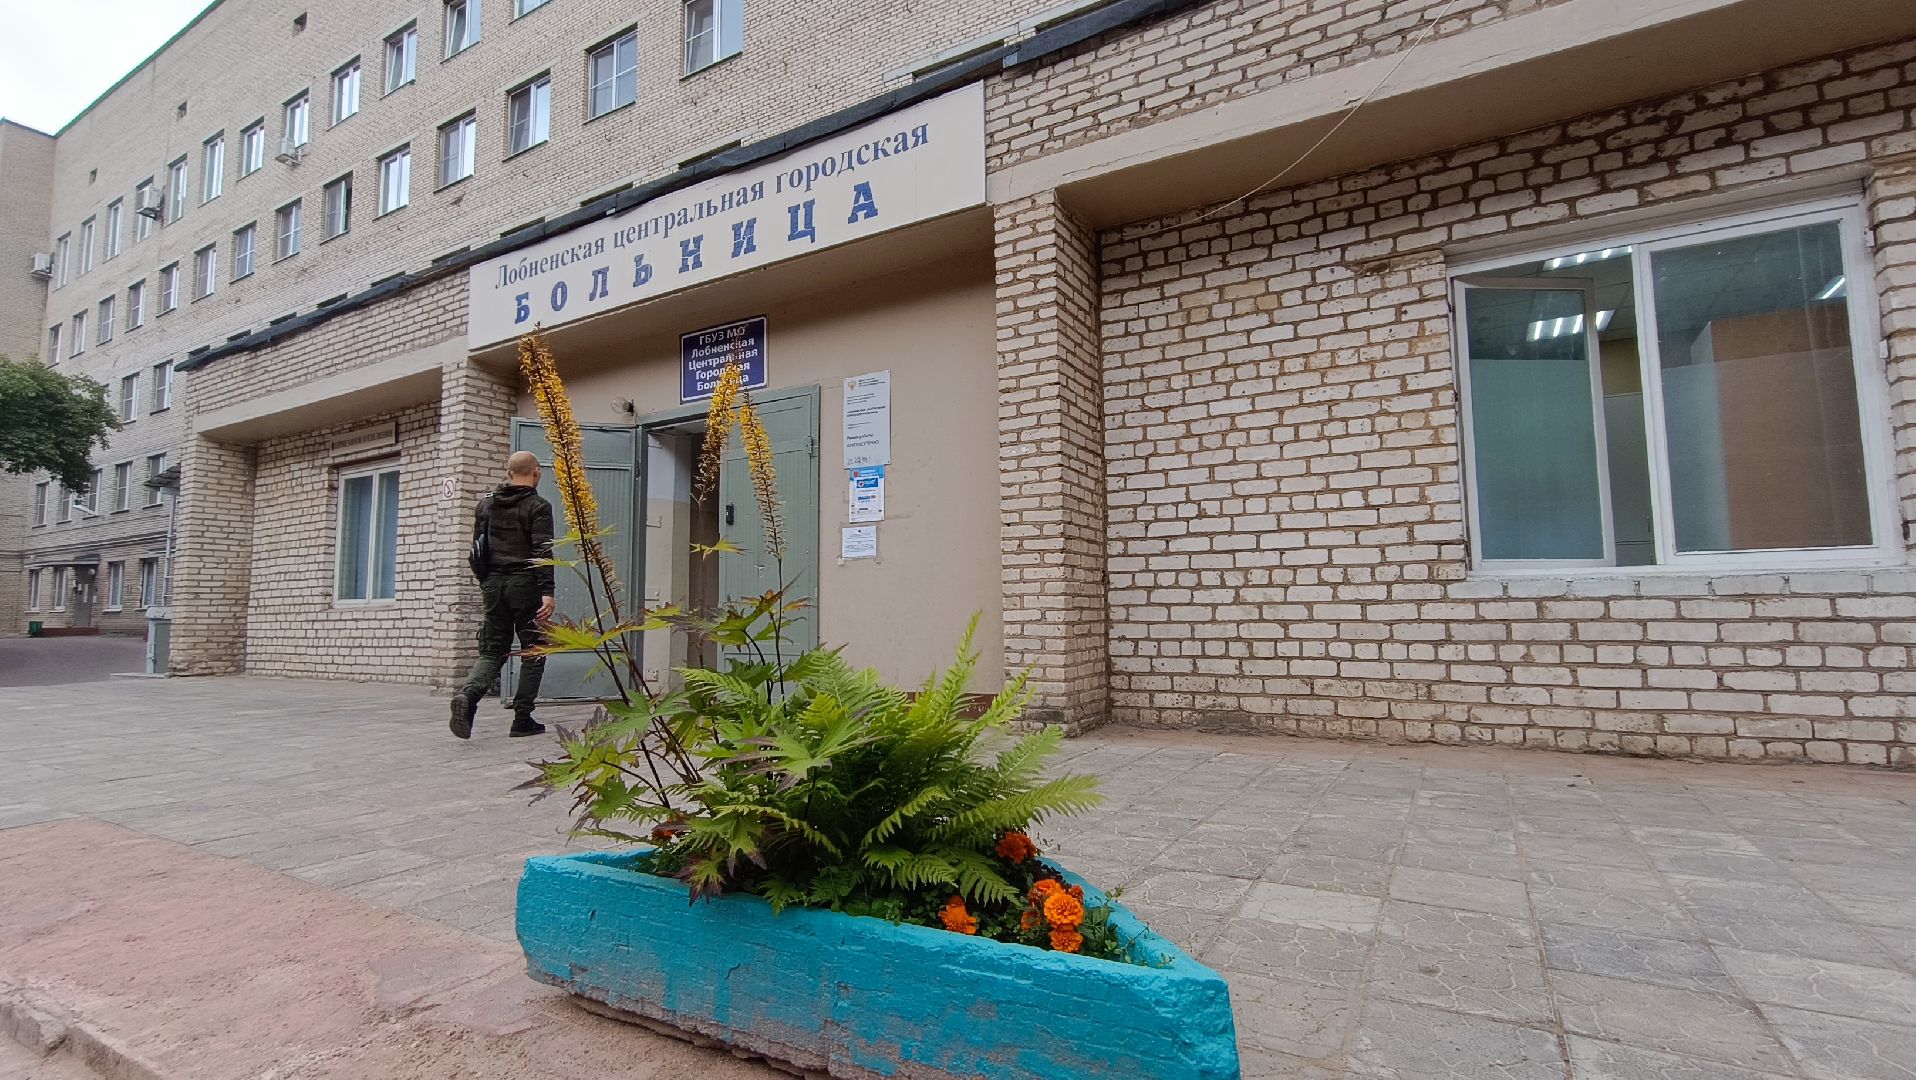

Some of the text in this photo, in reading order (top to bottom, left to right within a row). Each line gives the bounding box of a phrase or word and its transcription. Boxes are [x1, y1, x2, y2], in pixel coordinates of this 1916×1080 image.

[495, 123, 929, 289] Лобненская центральная городская
[514, 181, 879, 325] БОЛЬНИЦА
[699, 326, 746, 345] ГБУЗ МО
